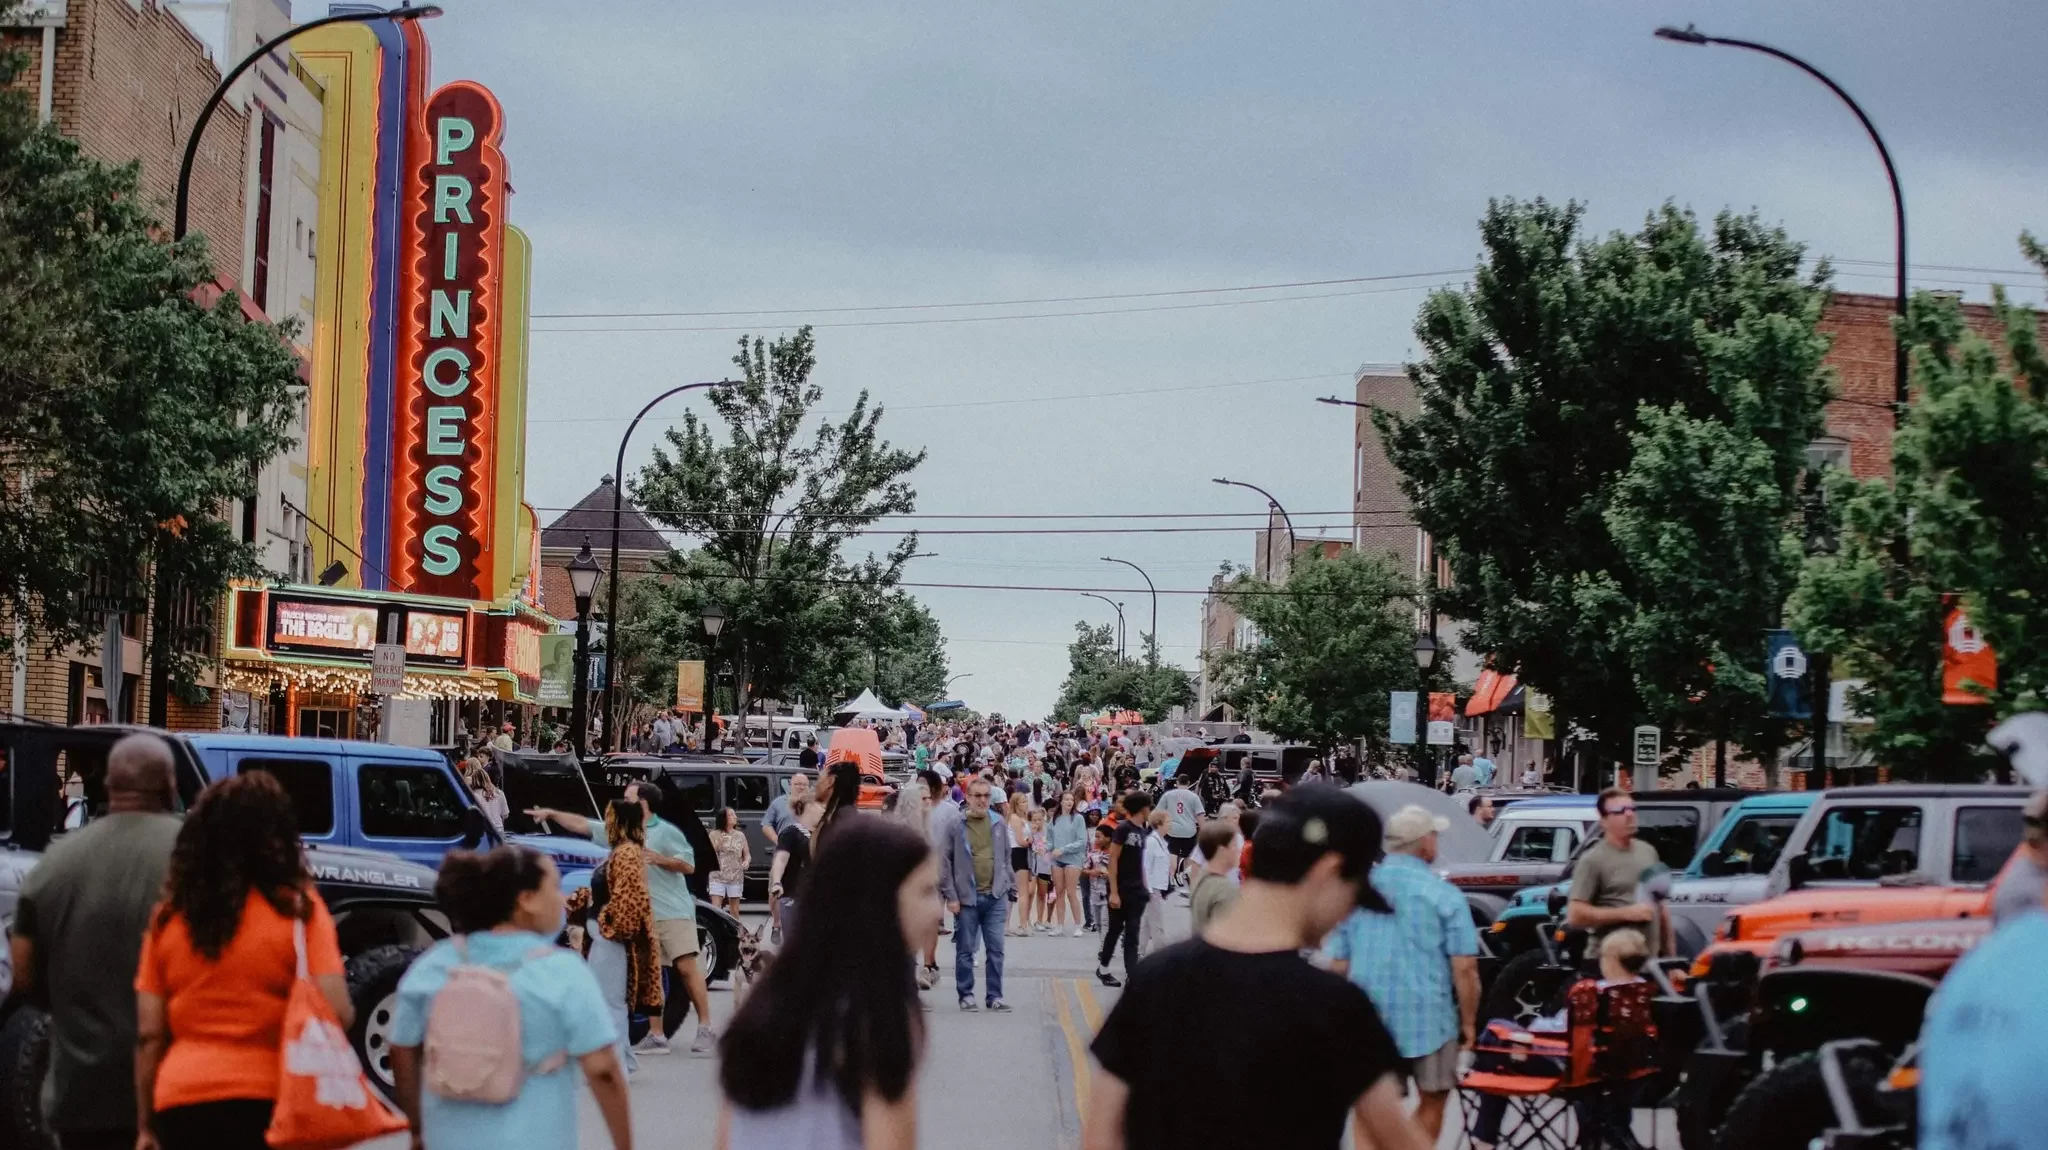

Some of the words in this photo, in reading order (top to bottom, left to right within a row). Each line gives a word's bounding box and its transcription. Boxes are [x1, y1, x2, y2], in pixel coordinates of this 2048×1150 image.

[422, 116, 475, 577] PRINCESS
[281, 618, 305, 637] THE
[383, 652, 396, 661] NO
[375, 664, 403, 675] REVERSE
[374, 677, 402, 688] PARKING
[306, 865, 421, 888] WRANGLER
